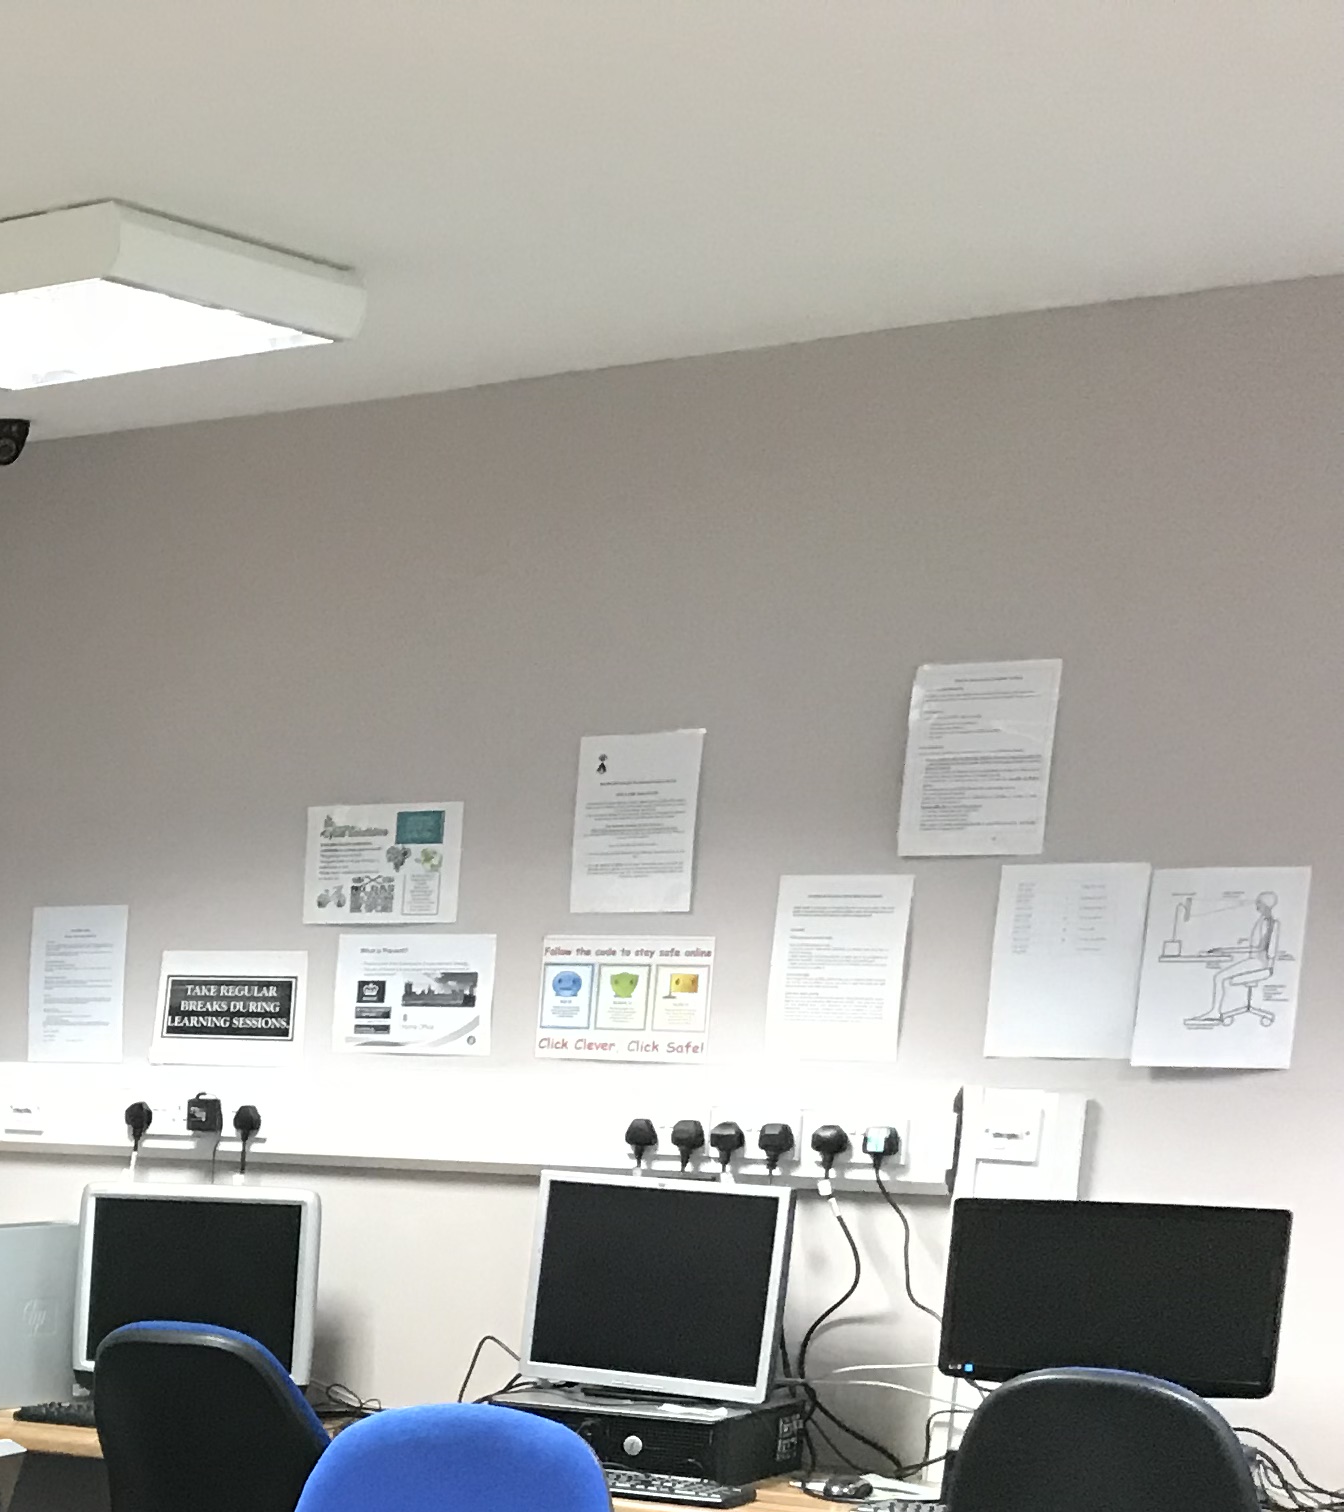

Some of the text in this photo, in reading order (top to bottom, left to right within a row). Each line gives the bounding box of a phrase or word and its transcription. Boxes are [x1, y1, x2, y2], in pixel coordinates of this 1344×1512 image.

[576, 946, 592, 956] the
[595, 947, 616, 957] code
[621, 948, 630, 957] to
[634, 948, 656, 958] stay
[659, 947, 680, 957] safe
[684, 947, 712, 958] online
[185, 985, 278, 997] TAKE REGULAR
[180, 1000, 281, 1013] BREAKS DURING
[168, 1015, 291, 1029] LEARNING SESSIONS.
[538, 1037, 569, 1050] Click
[627, 1040, 659, 1053] Click
